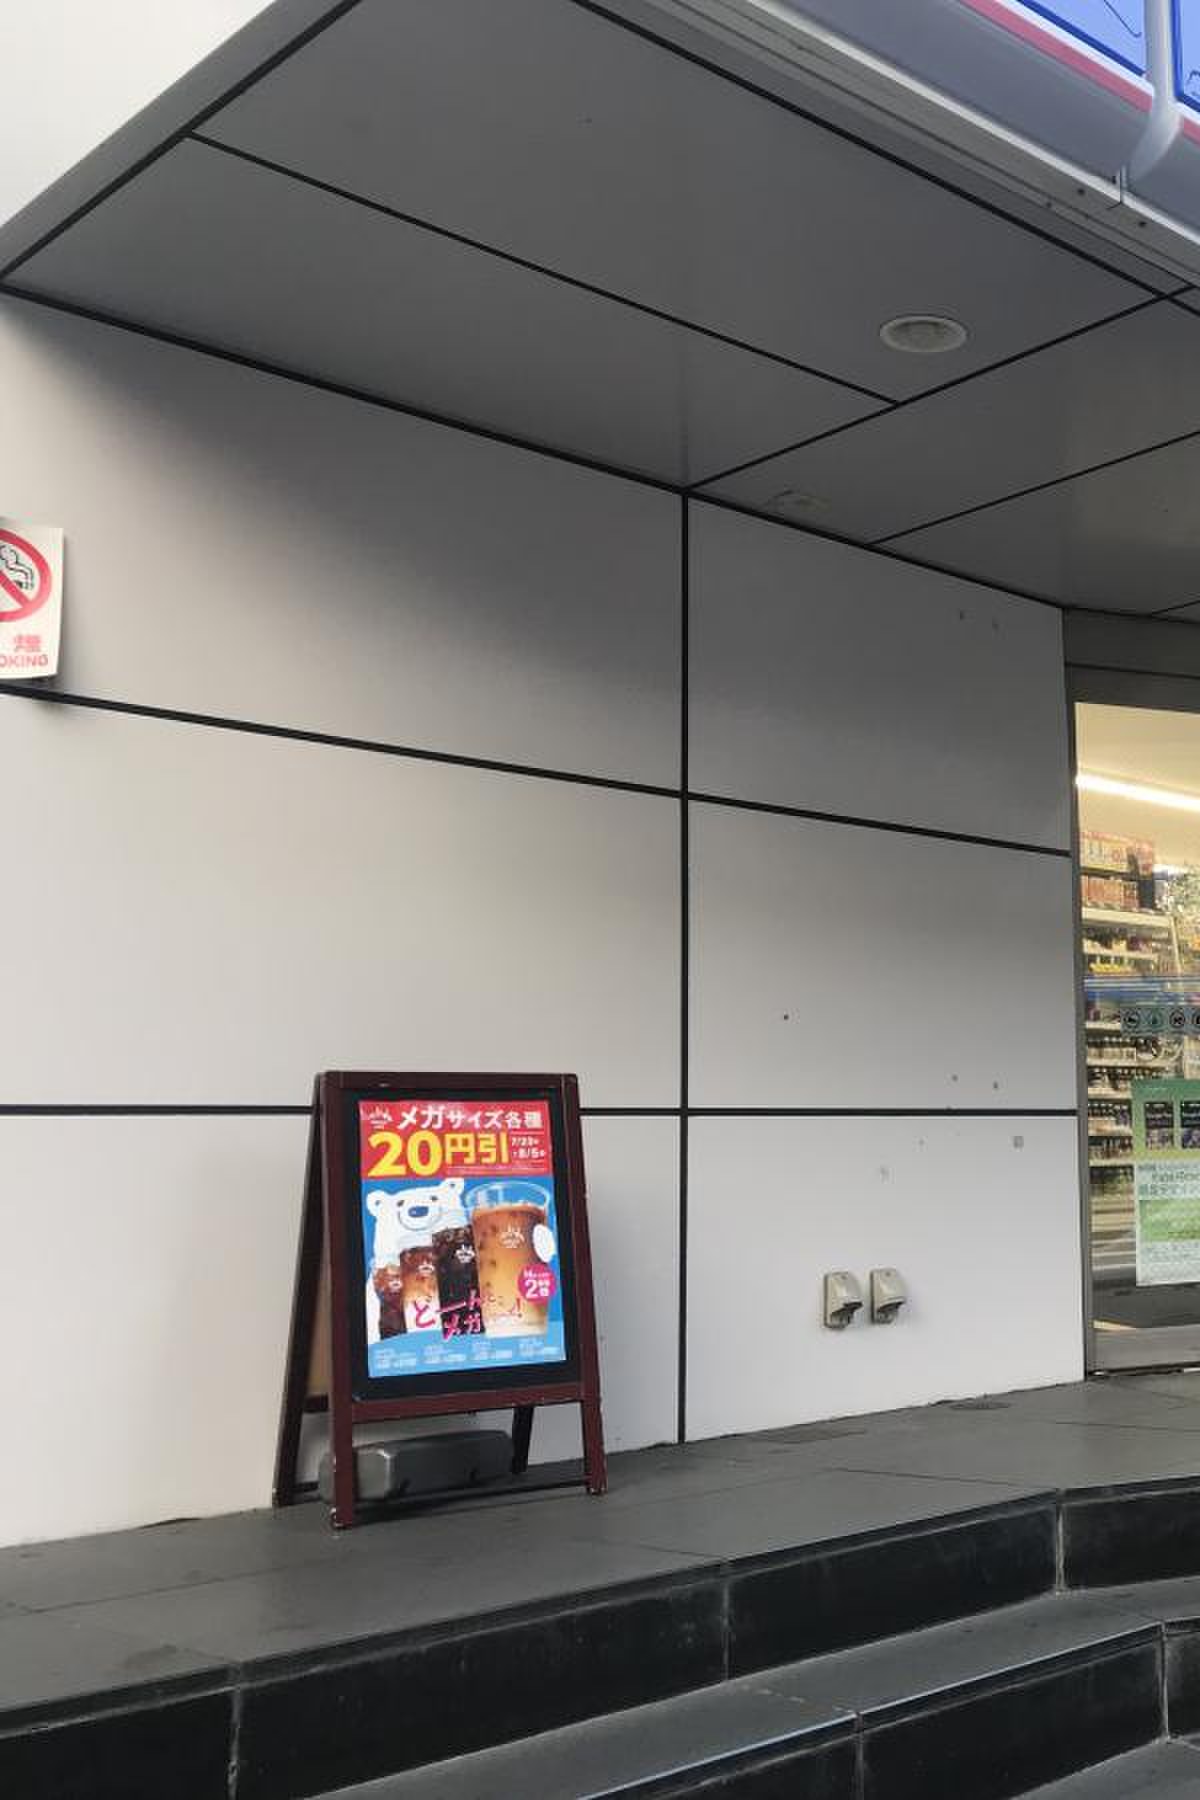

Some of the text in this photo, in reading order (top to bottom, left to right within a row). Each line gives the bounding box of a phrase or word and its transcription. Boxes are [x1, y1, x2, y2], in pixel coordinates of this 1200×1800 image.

[397, 1105, 543, 1129] メガサイズ各種
